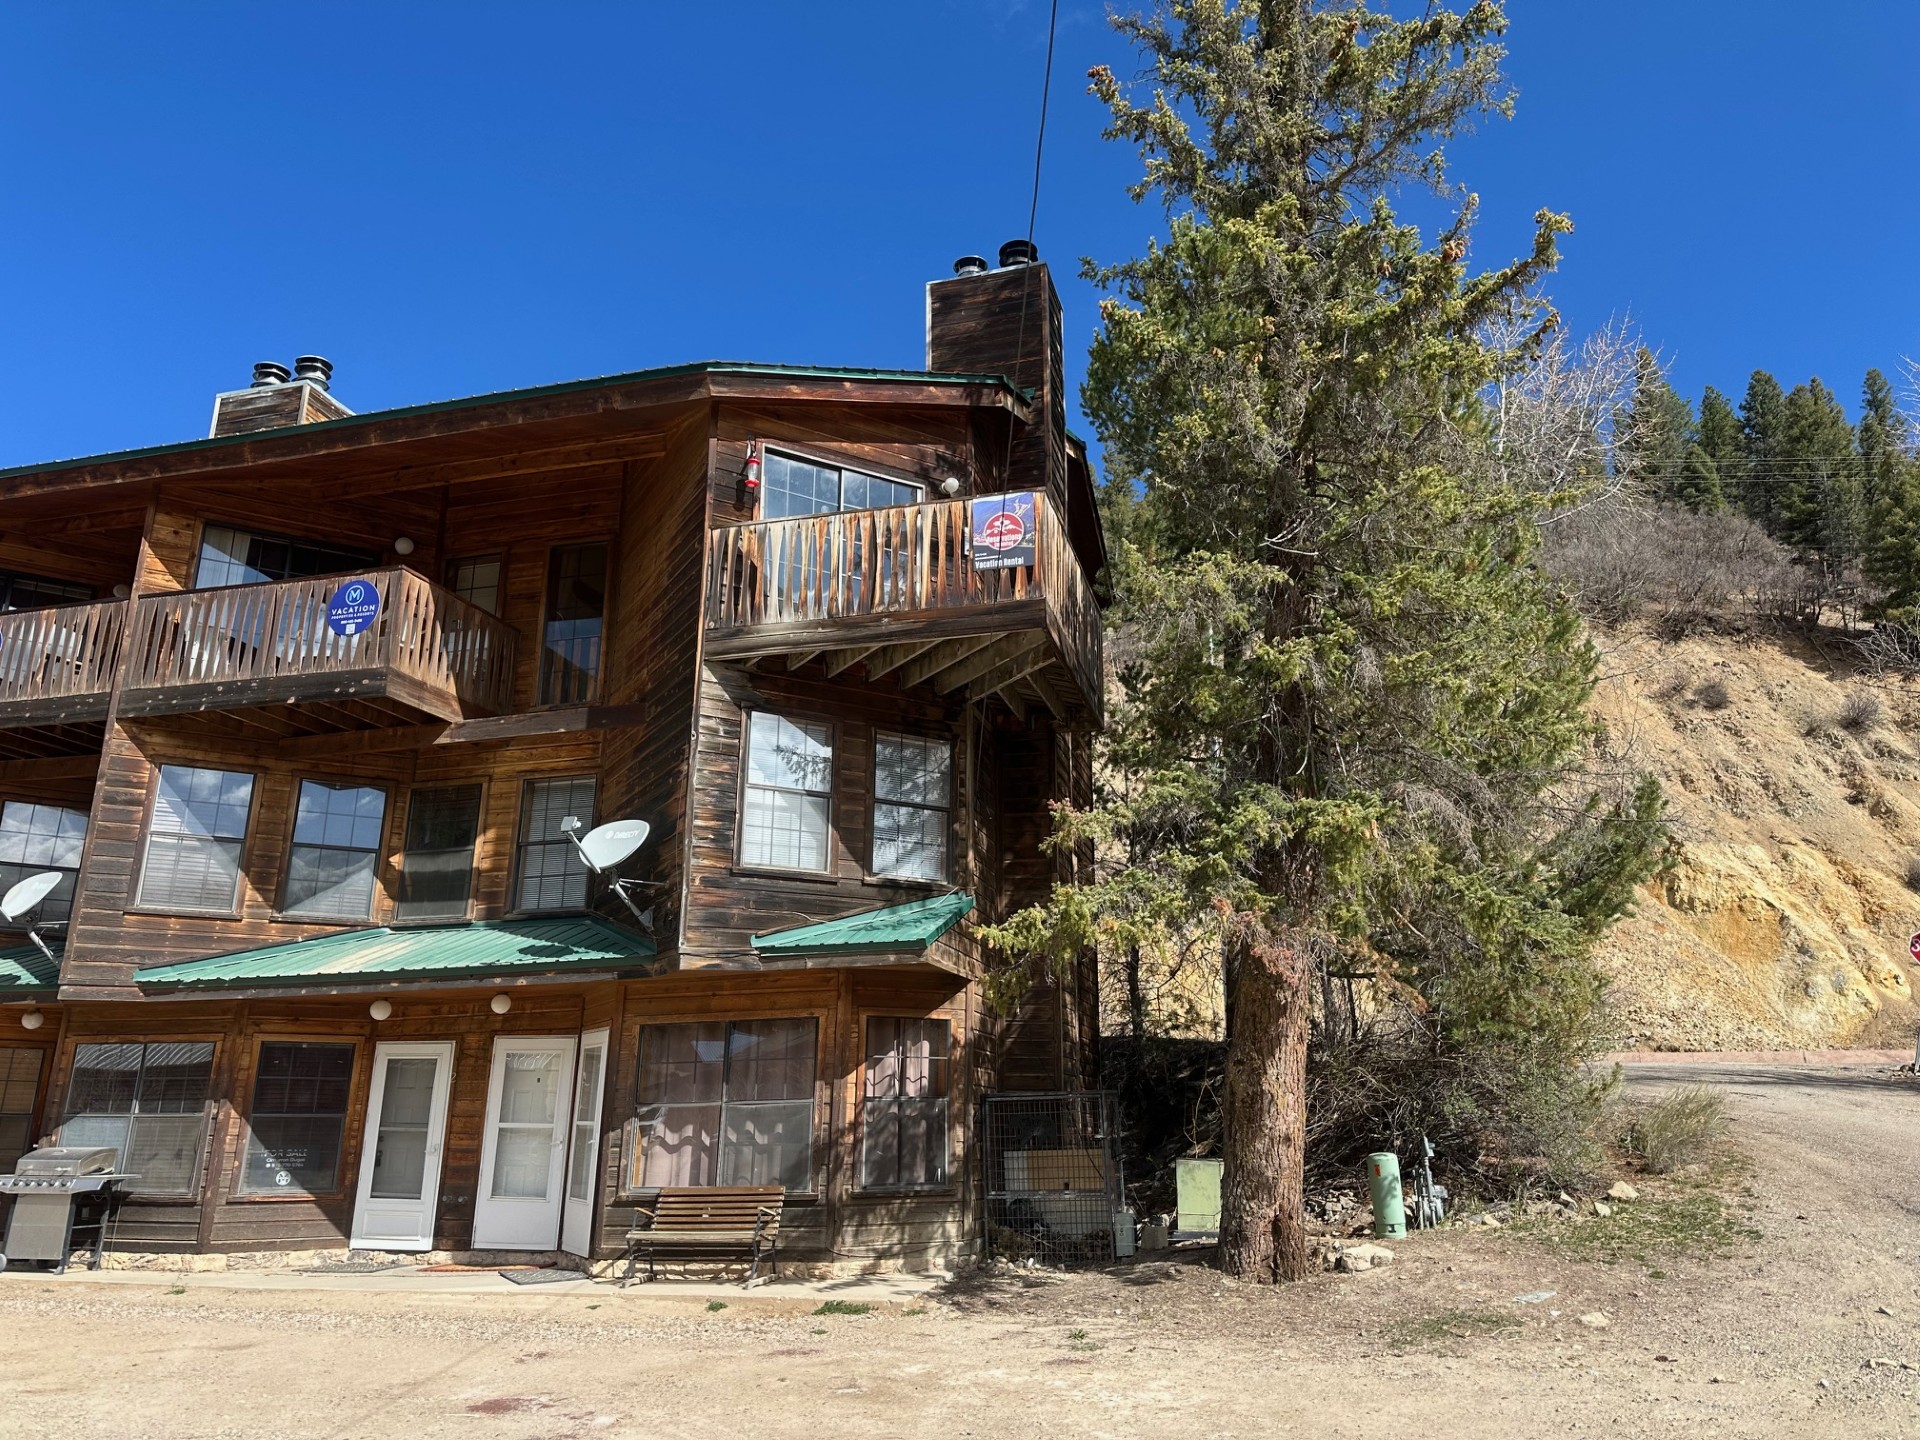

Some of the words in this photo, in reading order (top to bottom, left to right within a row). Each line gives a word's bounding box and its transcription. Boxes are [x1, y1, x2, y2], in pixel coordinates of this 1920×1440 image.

[975, 559, 1002, 569] Vacation
[1004, 556, 1024, 566] Rental
[331, 605, 375, 615] VACATION
[286, 1148, 308, 1157] SALE
